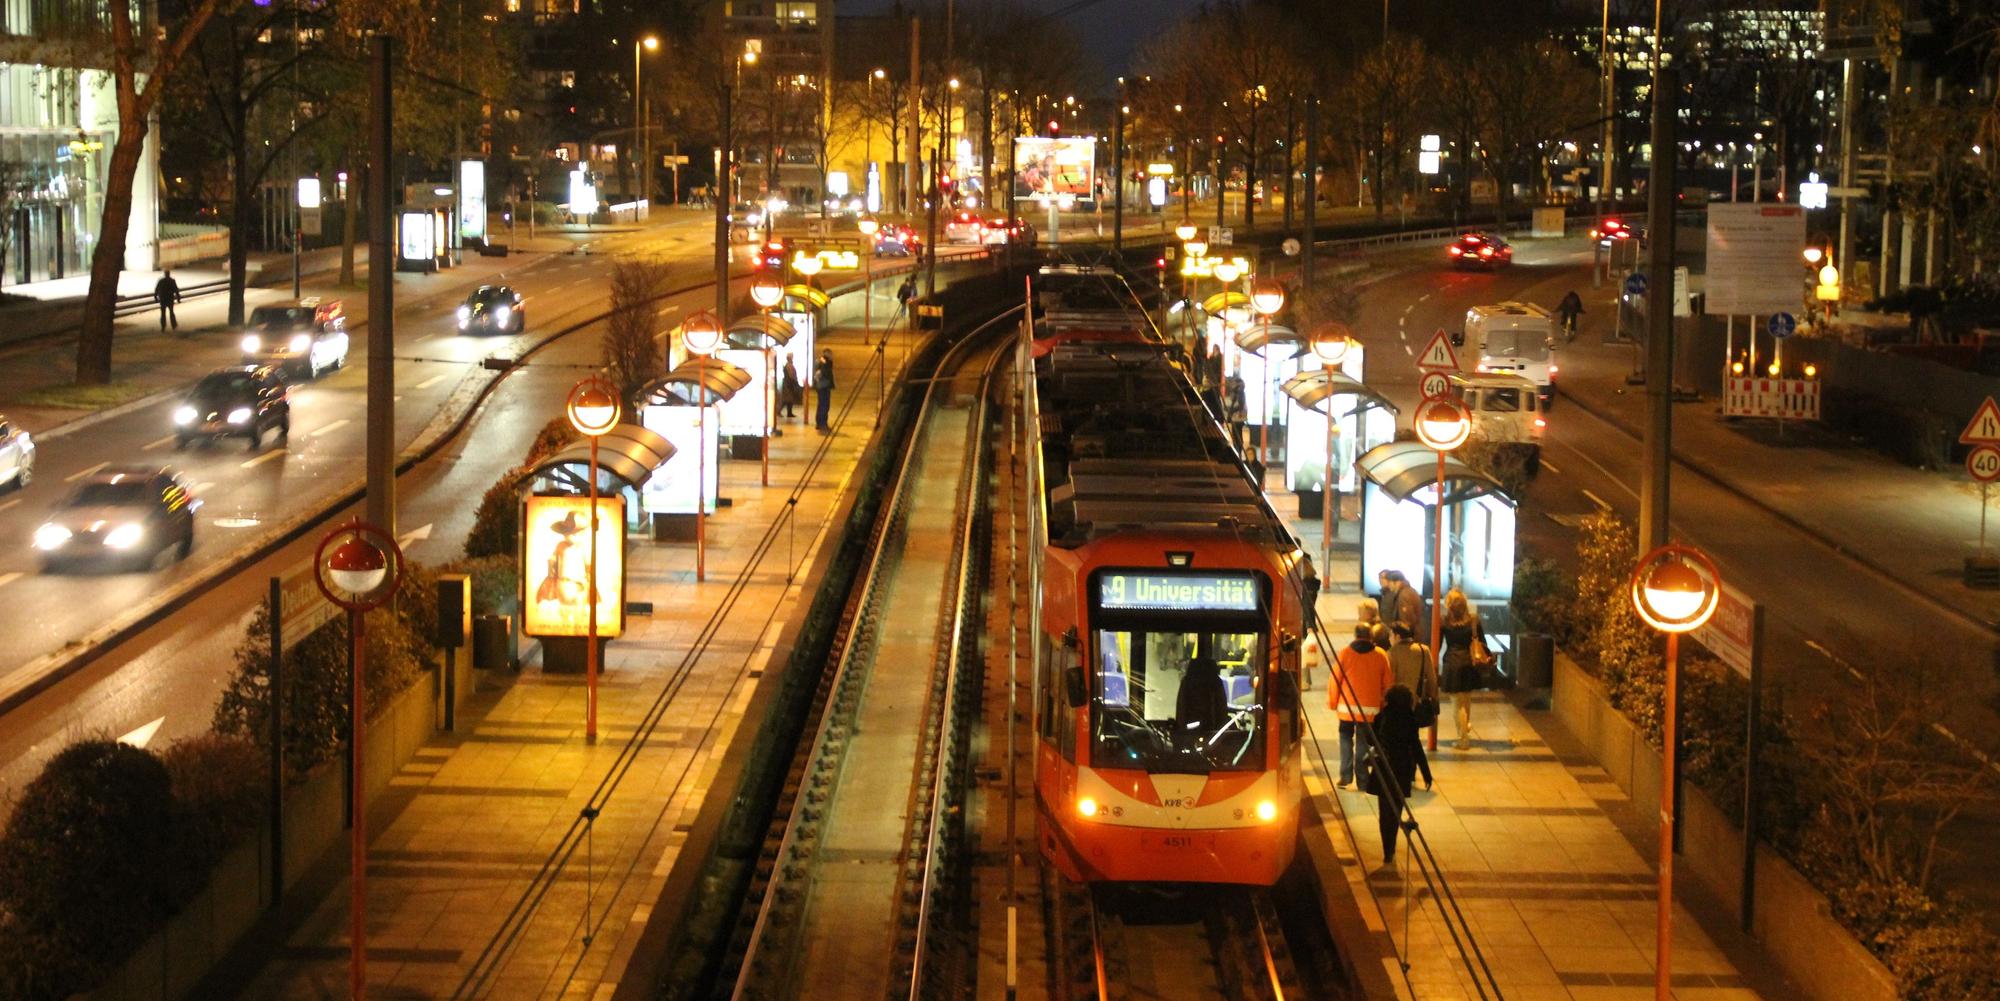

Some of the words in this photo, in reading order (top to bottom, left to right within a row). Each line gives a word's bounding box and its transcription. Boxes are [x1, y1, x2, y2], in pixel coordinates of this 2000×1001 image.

[1427, 380, 1445, 395] 40
[1975, 455, 1998, 472] 40
[1136, 578, 1253, 603] Universität
[1164, 799, 1182, 808] KVB
[1163, 837, 1192, 847] 4511
